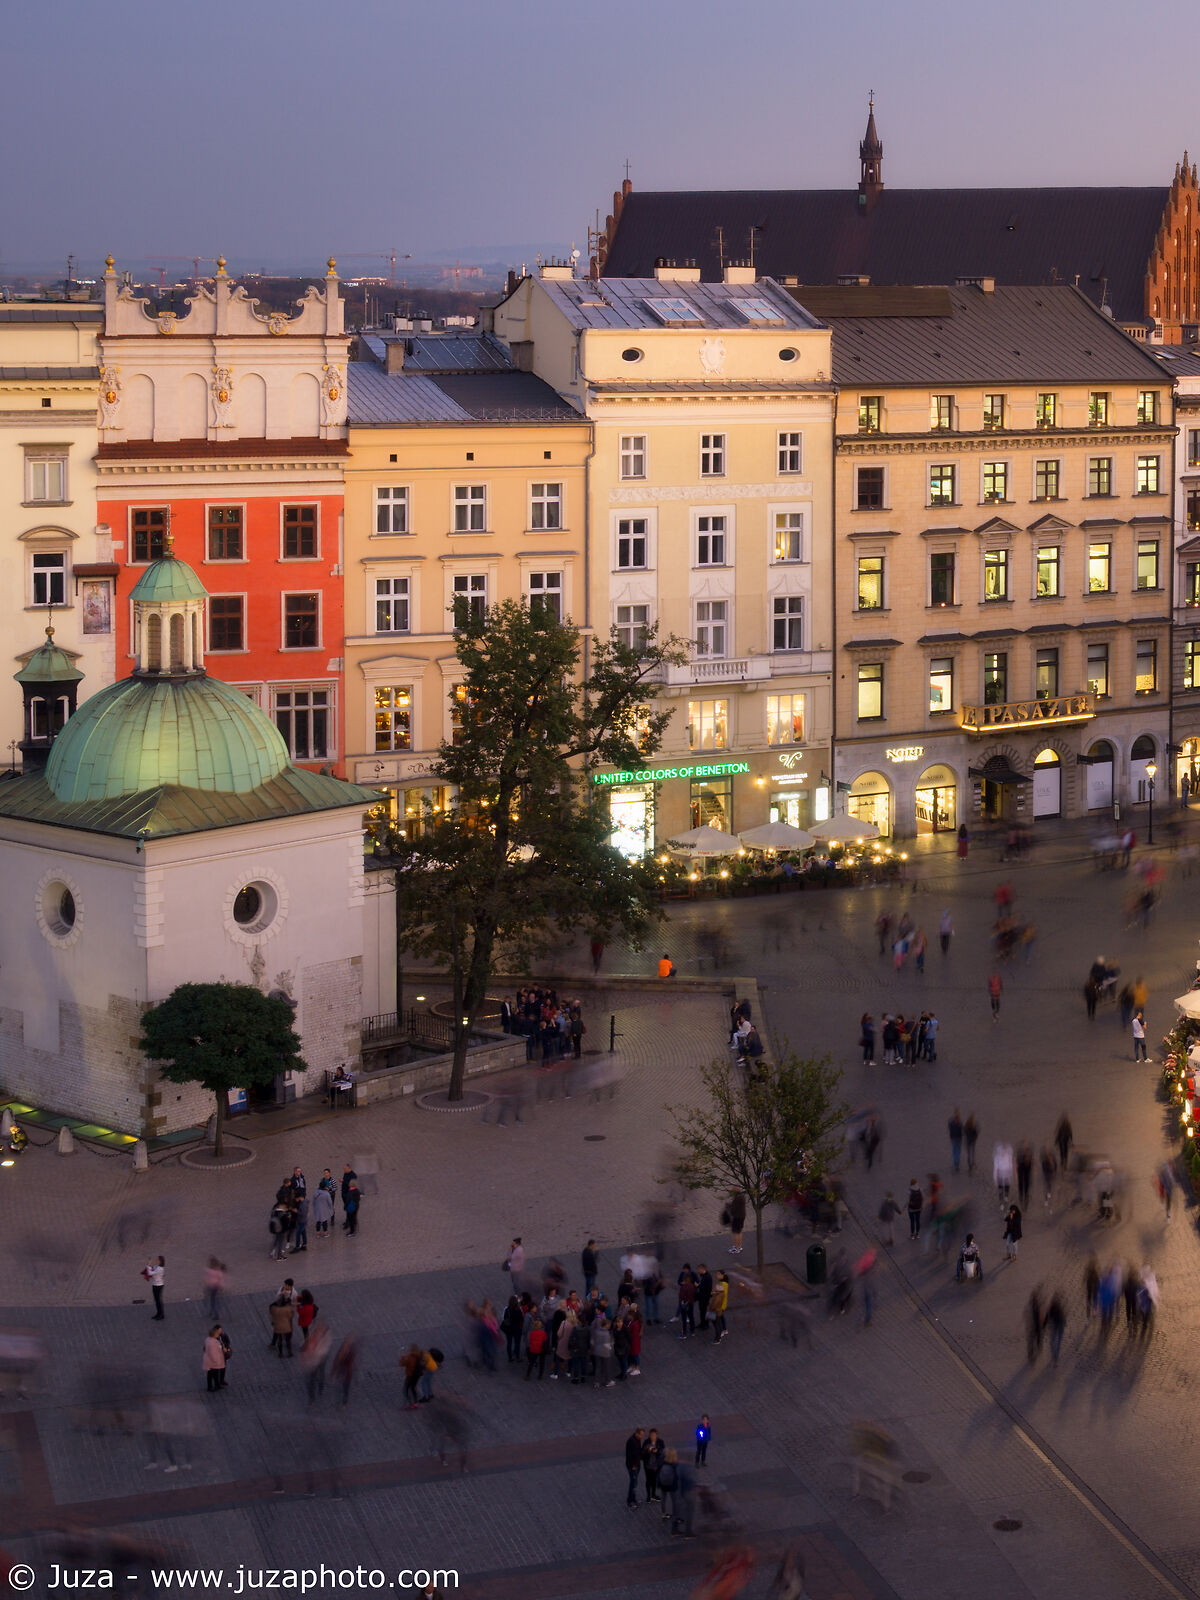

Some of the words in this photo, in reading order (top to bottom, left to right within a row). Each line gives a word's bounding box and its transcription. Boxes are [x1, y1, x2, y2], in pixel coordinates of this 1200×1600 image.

[886, 746, 925, 759] NORD
[594, 771, 634, 785] UNITED
[635, 768, 678, 781] COLORS
[679, 766, 694, 778] OF
